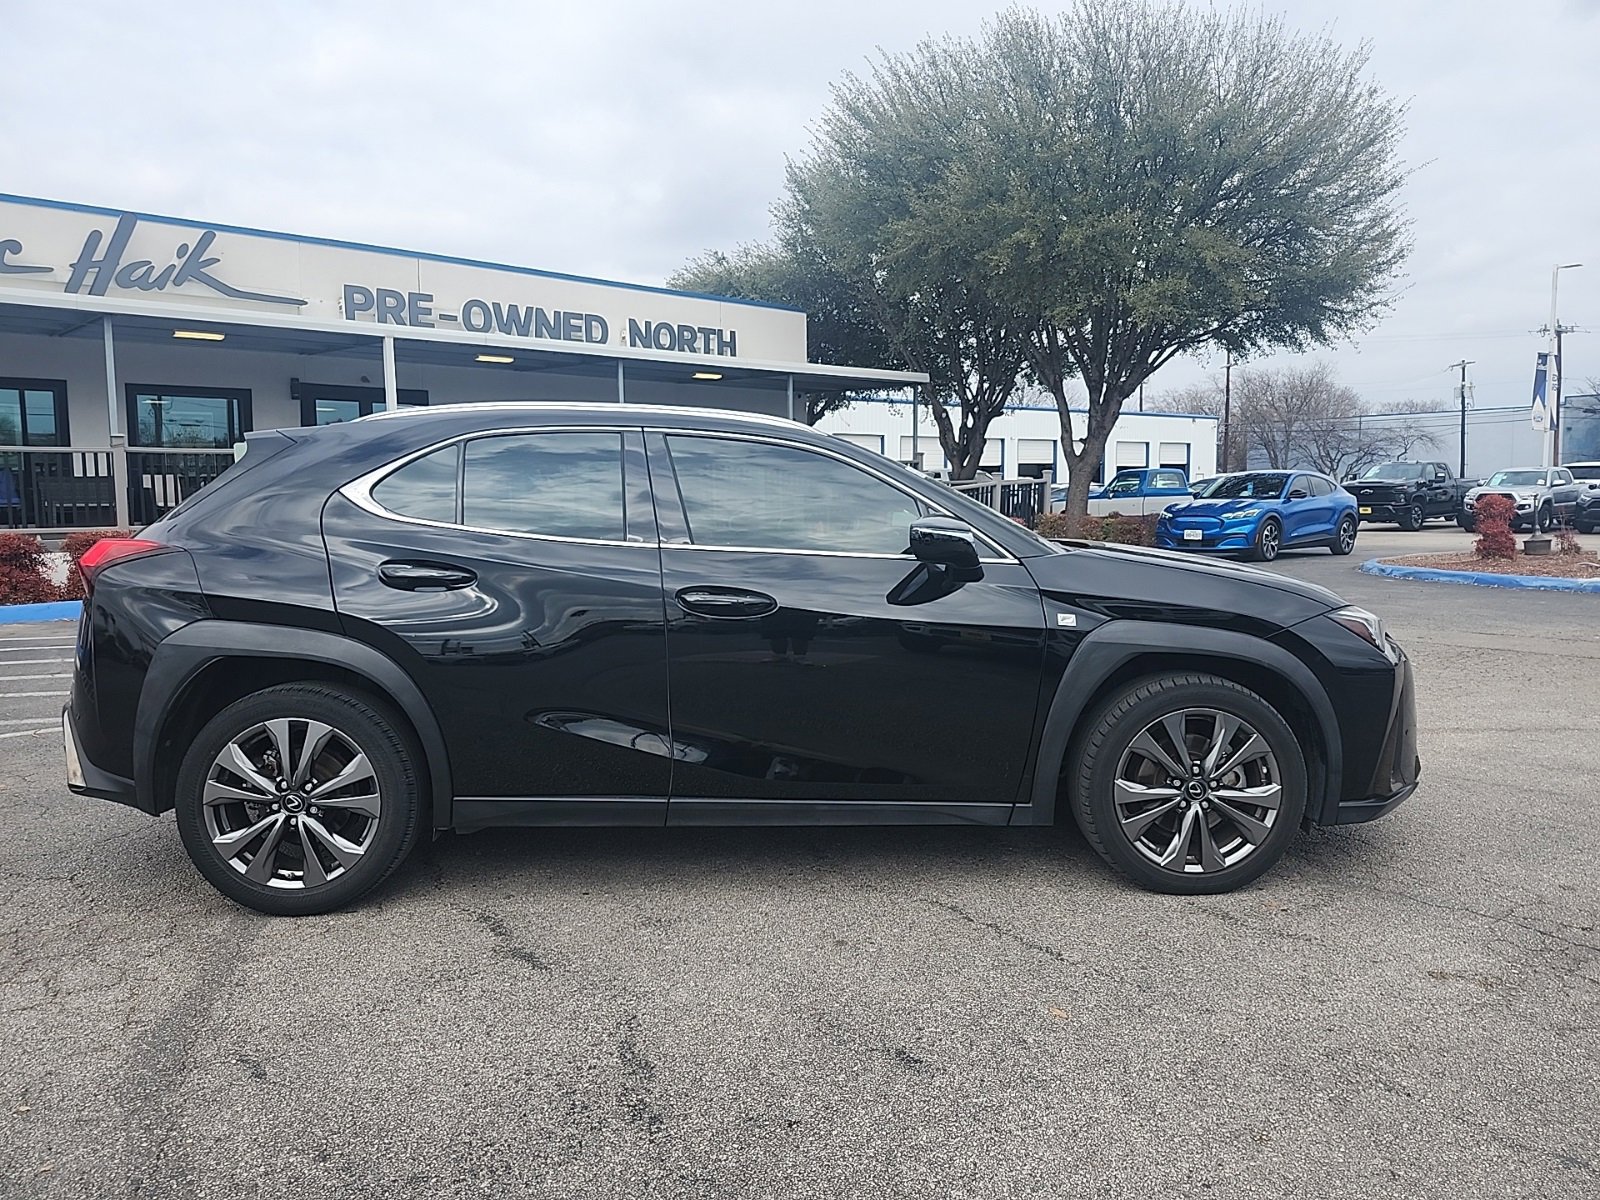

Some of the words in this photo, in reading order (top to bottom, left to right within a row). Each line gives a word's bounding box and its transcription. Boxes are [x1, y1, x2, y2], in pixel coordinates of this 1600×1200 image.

[64, 212, 308, 306] Haik
[343, 284, 609, 344] PRE-OWNED
[628, 318, 737, 357] NORTH
